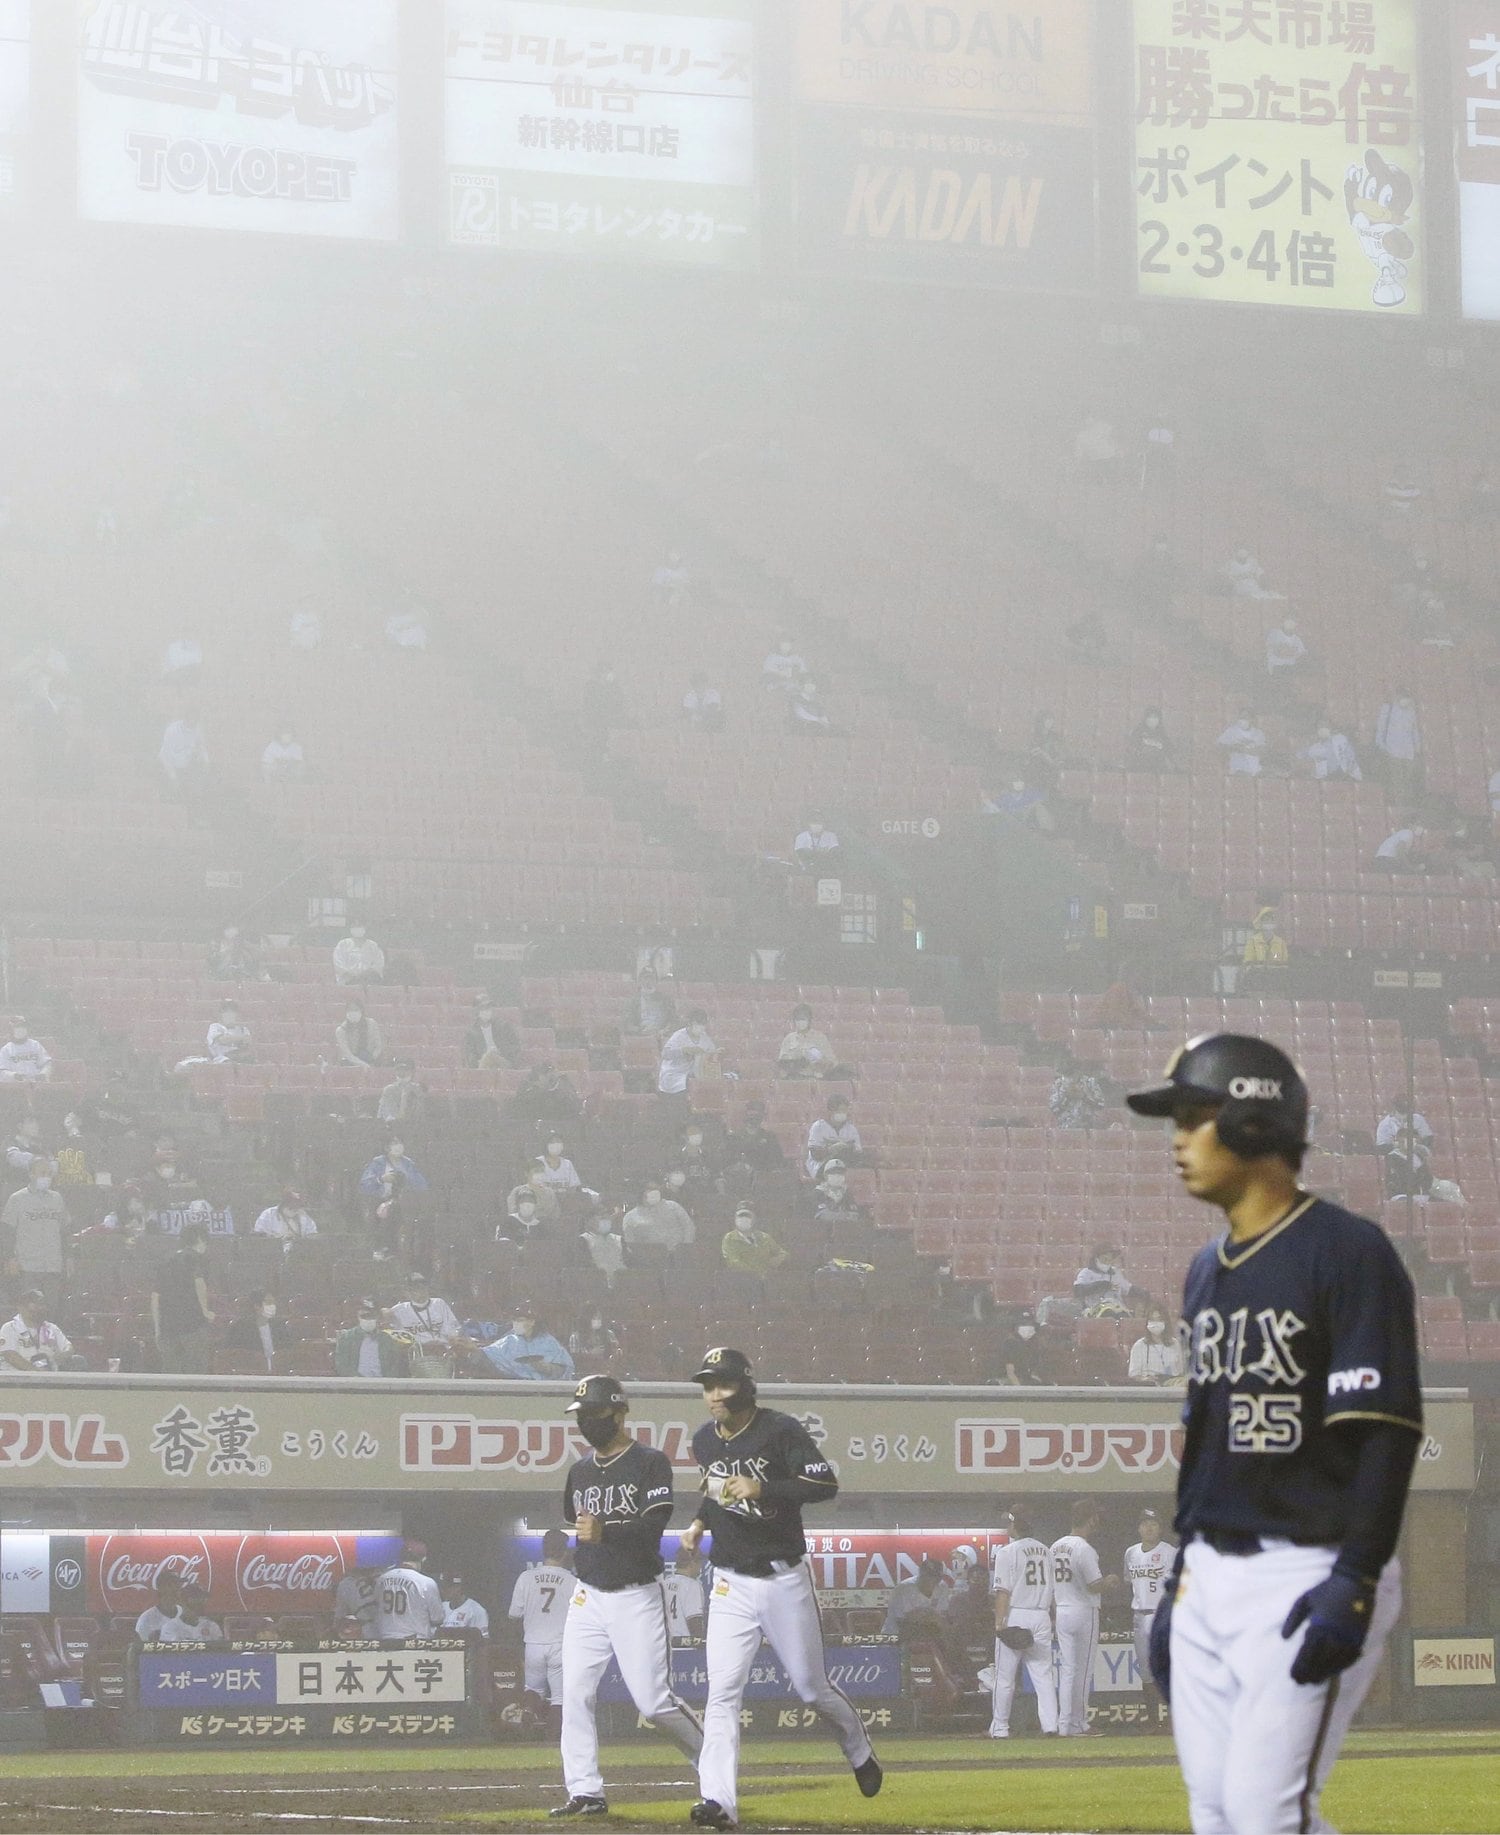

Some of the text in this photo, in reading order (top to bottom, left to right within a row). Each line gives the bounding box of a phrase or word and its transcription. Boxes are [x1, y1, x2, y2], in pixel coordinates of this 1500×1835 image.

[840, 0, 1042, 62] KADAN
[446, 28, 752, 82] トヨタレンタリース
[839, 57, 1047, 96] DRIVING SCHOOL
[551, 74, 639, 113] 仙台
[1137, 44, 1413, 146] 勝ったら倍
[517, 114, 679, 159] 新幹線口店
[125, 129, 357, 204] TOYOPET
[1137, 144, 1335, 217] ポイント
[509, 194, 749, 242] トヨタレンタカー
[842, 164, 1046, 249] KADAN
[881, 820, 919, 834] GATE
[1228, 1076, 1284, 1100] ORIX
[1228, 1392, 1302, 1453] 25
[281, 1432, 379, 1458] こうくん
[849, 1434, 936, 1460] こうくん
[646, 1486, 670, 1499] FWD
[242, 1554, 338, 1590] Coca-Cola
[534, 1574, 563, 1586] SUZUKI
[1025, 1559, 1047, 1586] 21
[540, 1587, 557, 1613] 7
[1149, 1582, 1157, 1593] 5
[383, 1589, 407, 1616] 90
[828, 1656, 887, 1684] mio
[1446, 1653, 1492, 1670] KIRIN
[157, 1658, 443, 1696] スポーツ日大 日本大学
[180, 1715, 306, 1735] K's ケーズデンキ
[332, 1714, 455, 1734] K's ケーズデンキ
[777, 1708, 799, 1728] K's
